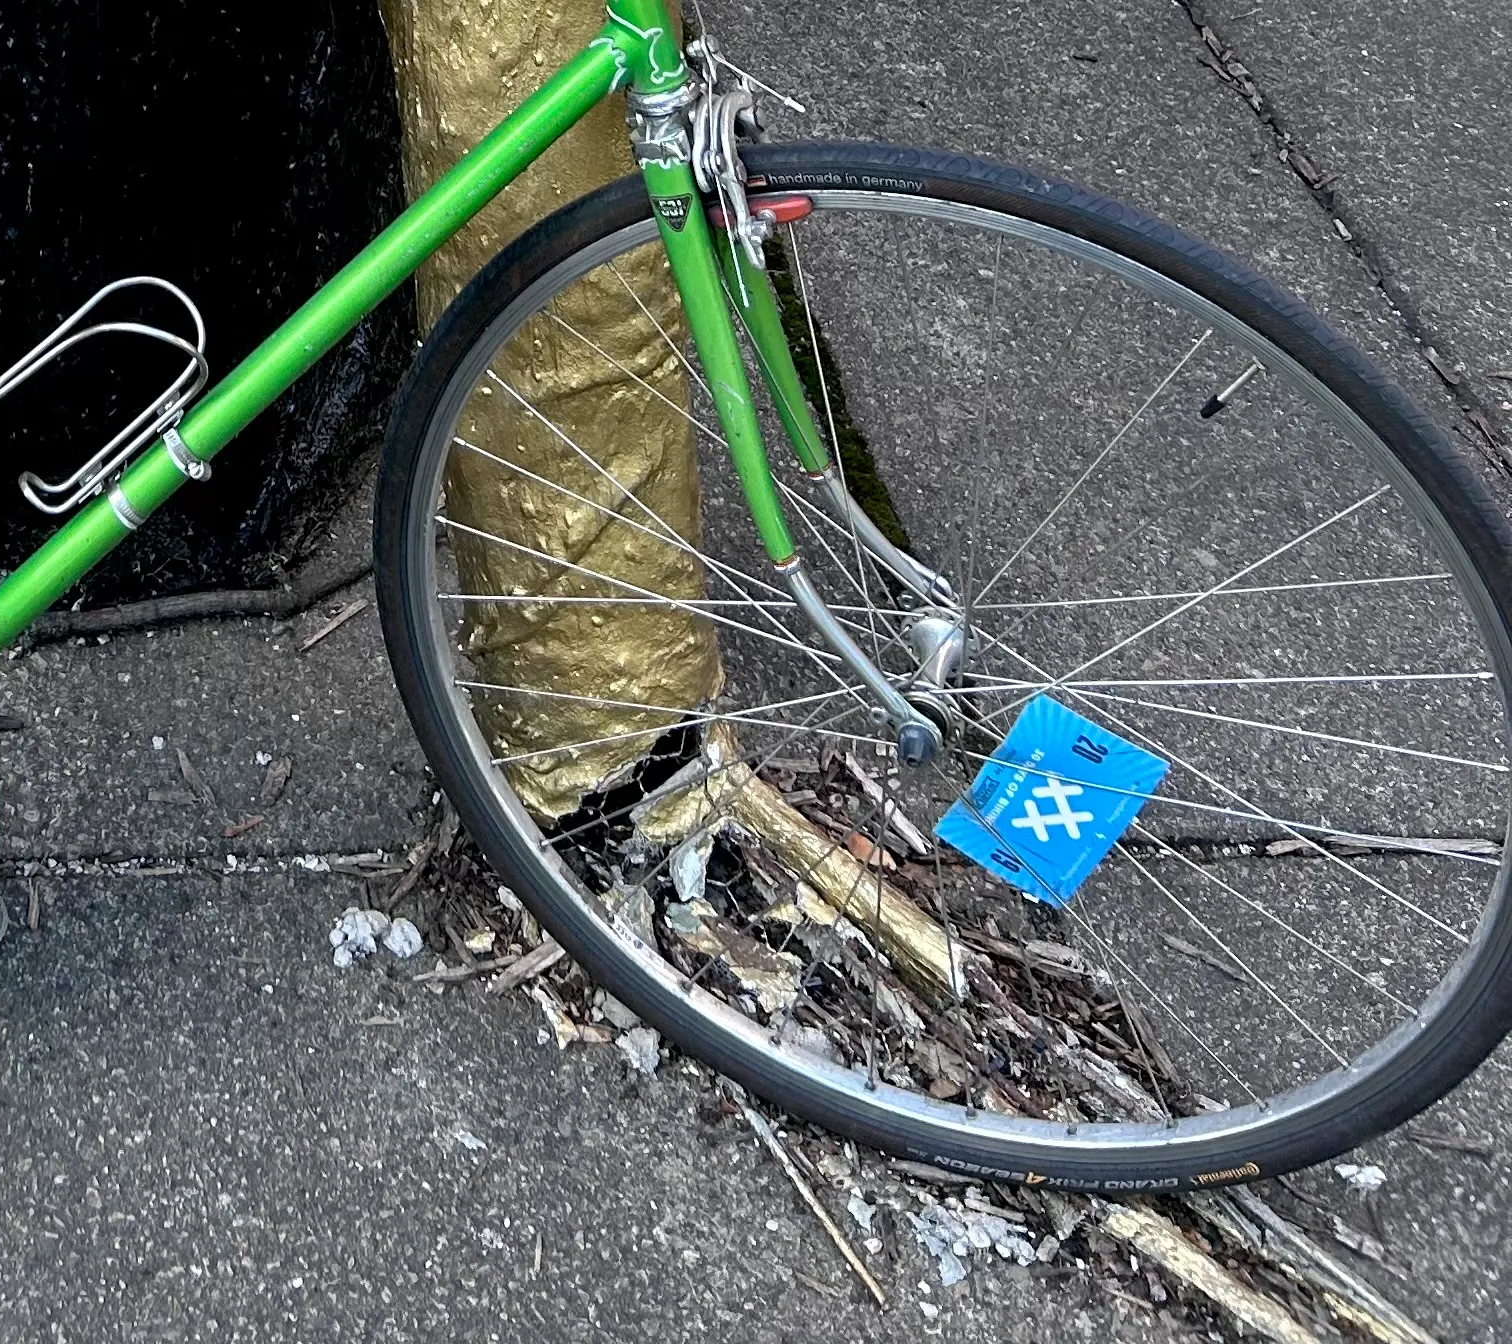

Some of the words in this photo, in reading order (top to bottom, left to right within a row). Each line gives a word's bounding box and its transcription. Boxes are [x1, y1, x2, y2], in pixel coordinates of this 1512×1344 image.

[768, 172, 842, 186] handmade
[844, 172, 858, 185] in
[861, 174, 923, 192] germany
[1072, 735, 1109, 764] 20
[1004, 781, 1019, 800] OF
[989, 847, 1022, 873] 19
[1047, 1176, 1101, 1190] PRIX
[1104, 1176, 1180, 1190] GRAND
[1196, 1161, 1261, 1186] Continental
